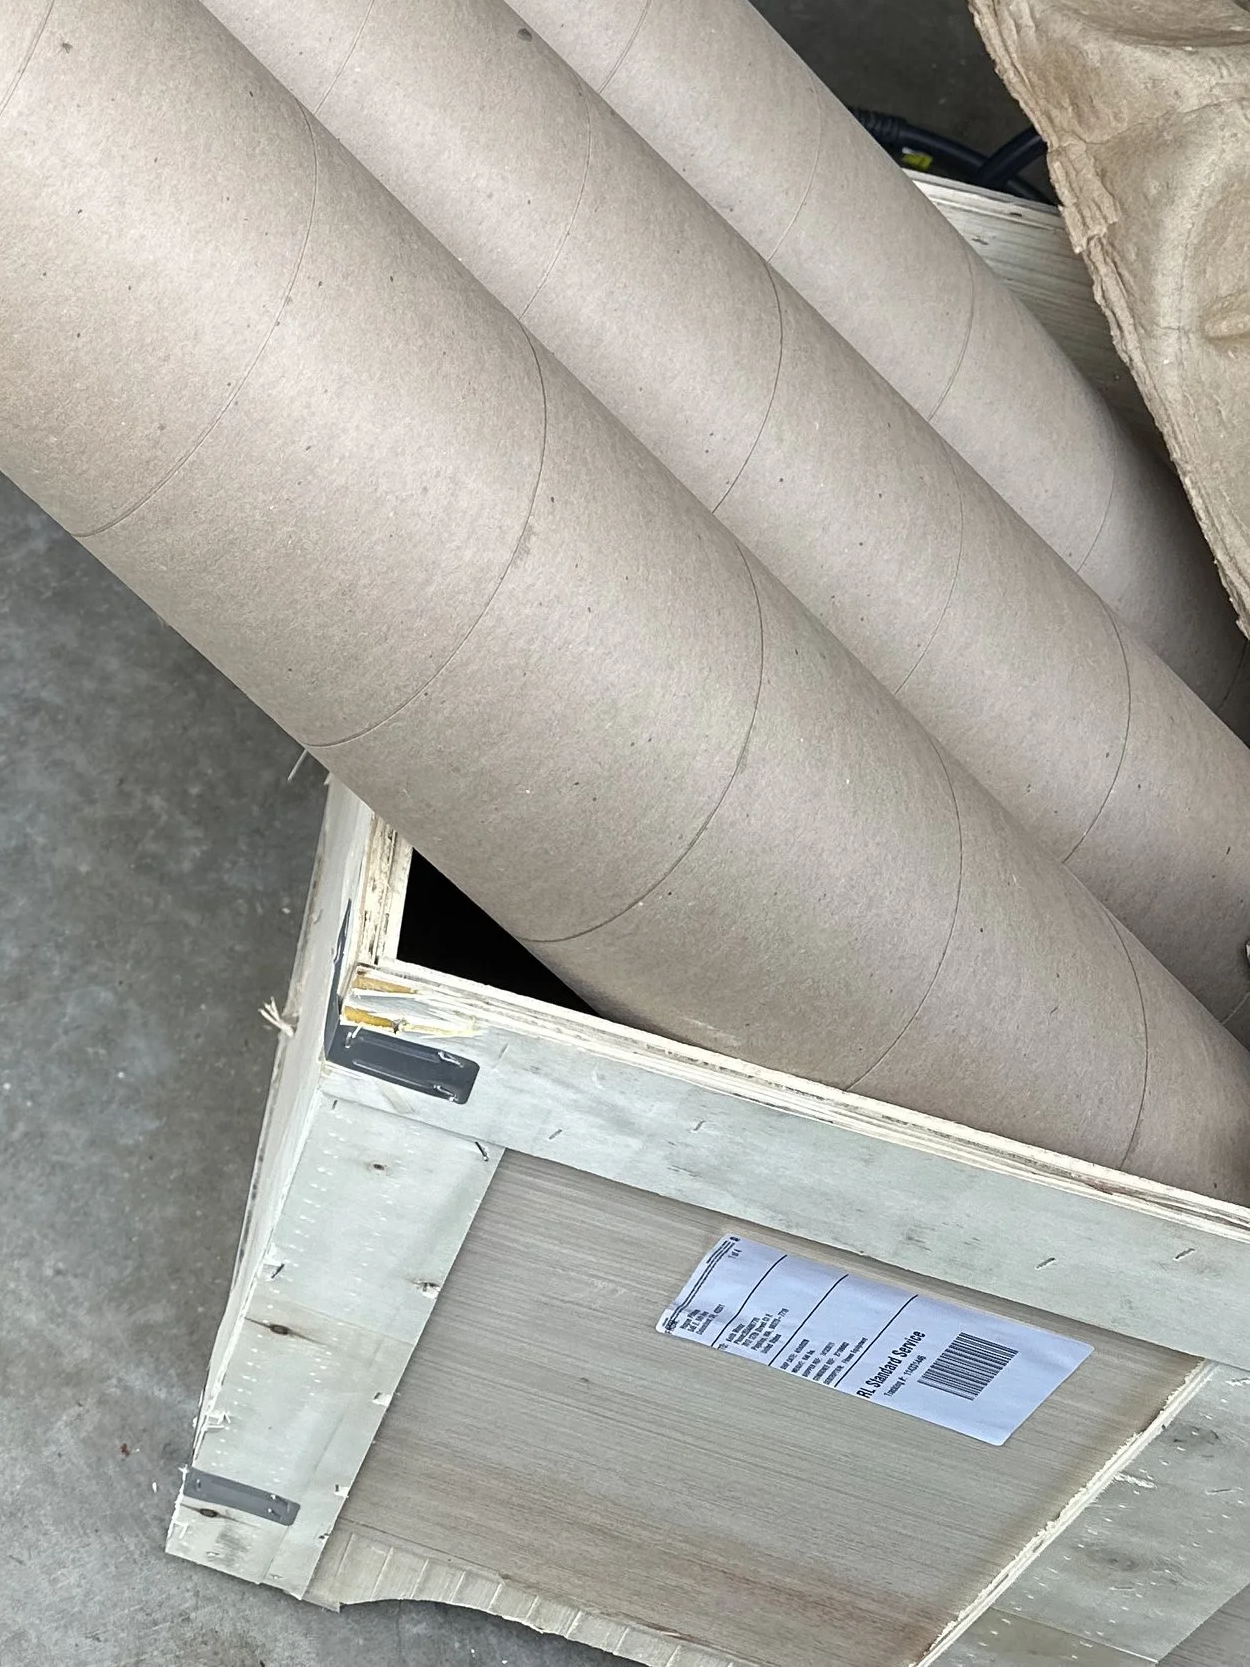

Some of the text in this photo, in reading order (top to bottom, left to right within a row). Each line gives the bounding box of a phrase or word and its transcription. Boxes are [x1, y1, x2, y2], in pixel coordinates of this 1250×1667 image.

[856, 1330, 926, 1399] RL Standard Service
